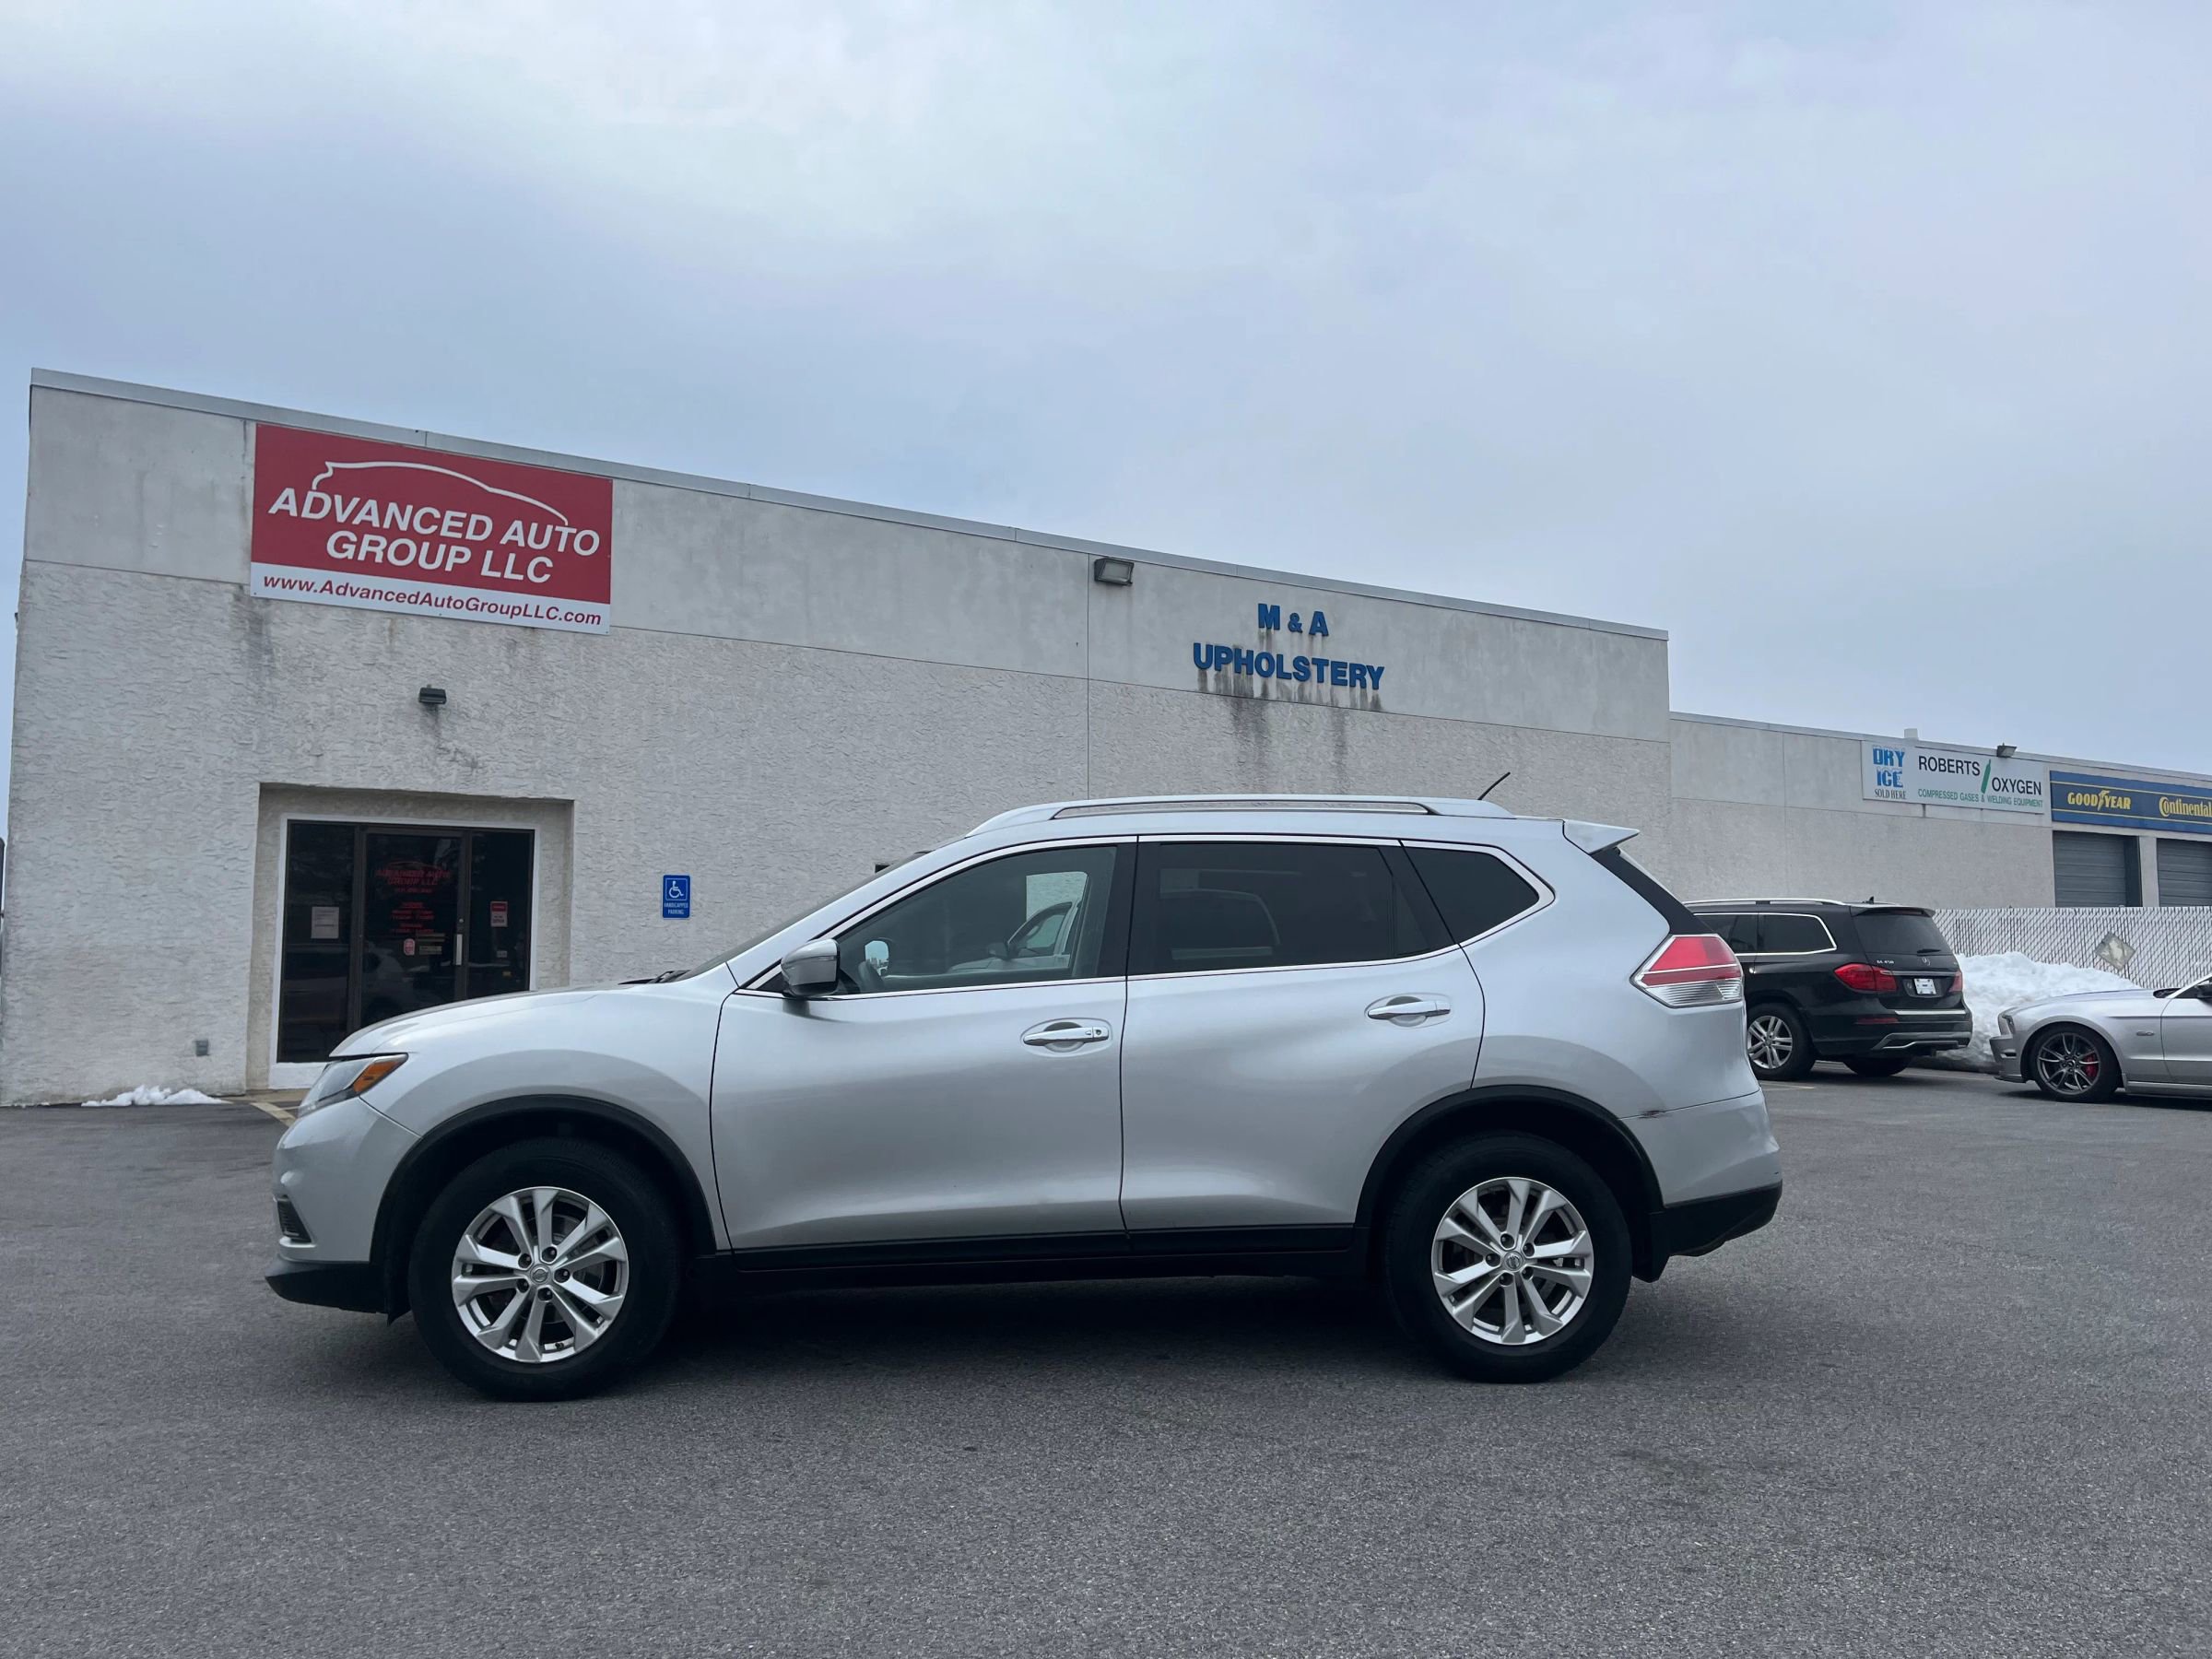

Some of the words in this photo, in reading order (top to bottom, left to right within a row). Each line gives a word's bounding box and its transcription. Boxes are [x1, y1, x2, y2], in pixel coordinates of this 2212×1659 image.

[268, 487, 493, 542] ADVANCED
[500, 520, 601, 557] AUTO
[325, 529, 471, 572] GROUP
[480, 550, 554, 583] LLC
[263, 576, 602, 626] www.AdvancedAutoGroupLLC.com
[1258, 603, 1280, 630] M
[1288, 612, 1303, 633] &
[1309, 610, 1329, 636] A
[1193, 642, 1385, 690] UPHOLSTERY
[1873, 747, 1905, 767] DRY
[1918, 756, 1981, 776] ROBERTS
[1877, 770, 1903, 788] ICE
[1992, 777, 2042, 795] OXYGEN
[1875, 789, 1890, 799] SOLD
[1890, 790, 1907, 800] HERE
[1918, 788, 1958, 801] COMPRESSED
[1959, 793, 1979, 802] GASES
[1987, 795, 2012, 806] WELDING
[2013, 798, 2043, 808] EQUIPMENT
[2067, 790, 2132, 811] GOODYEAR
[2159, 796, 2212, 818] Continental
